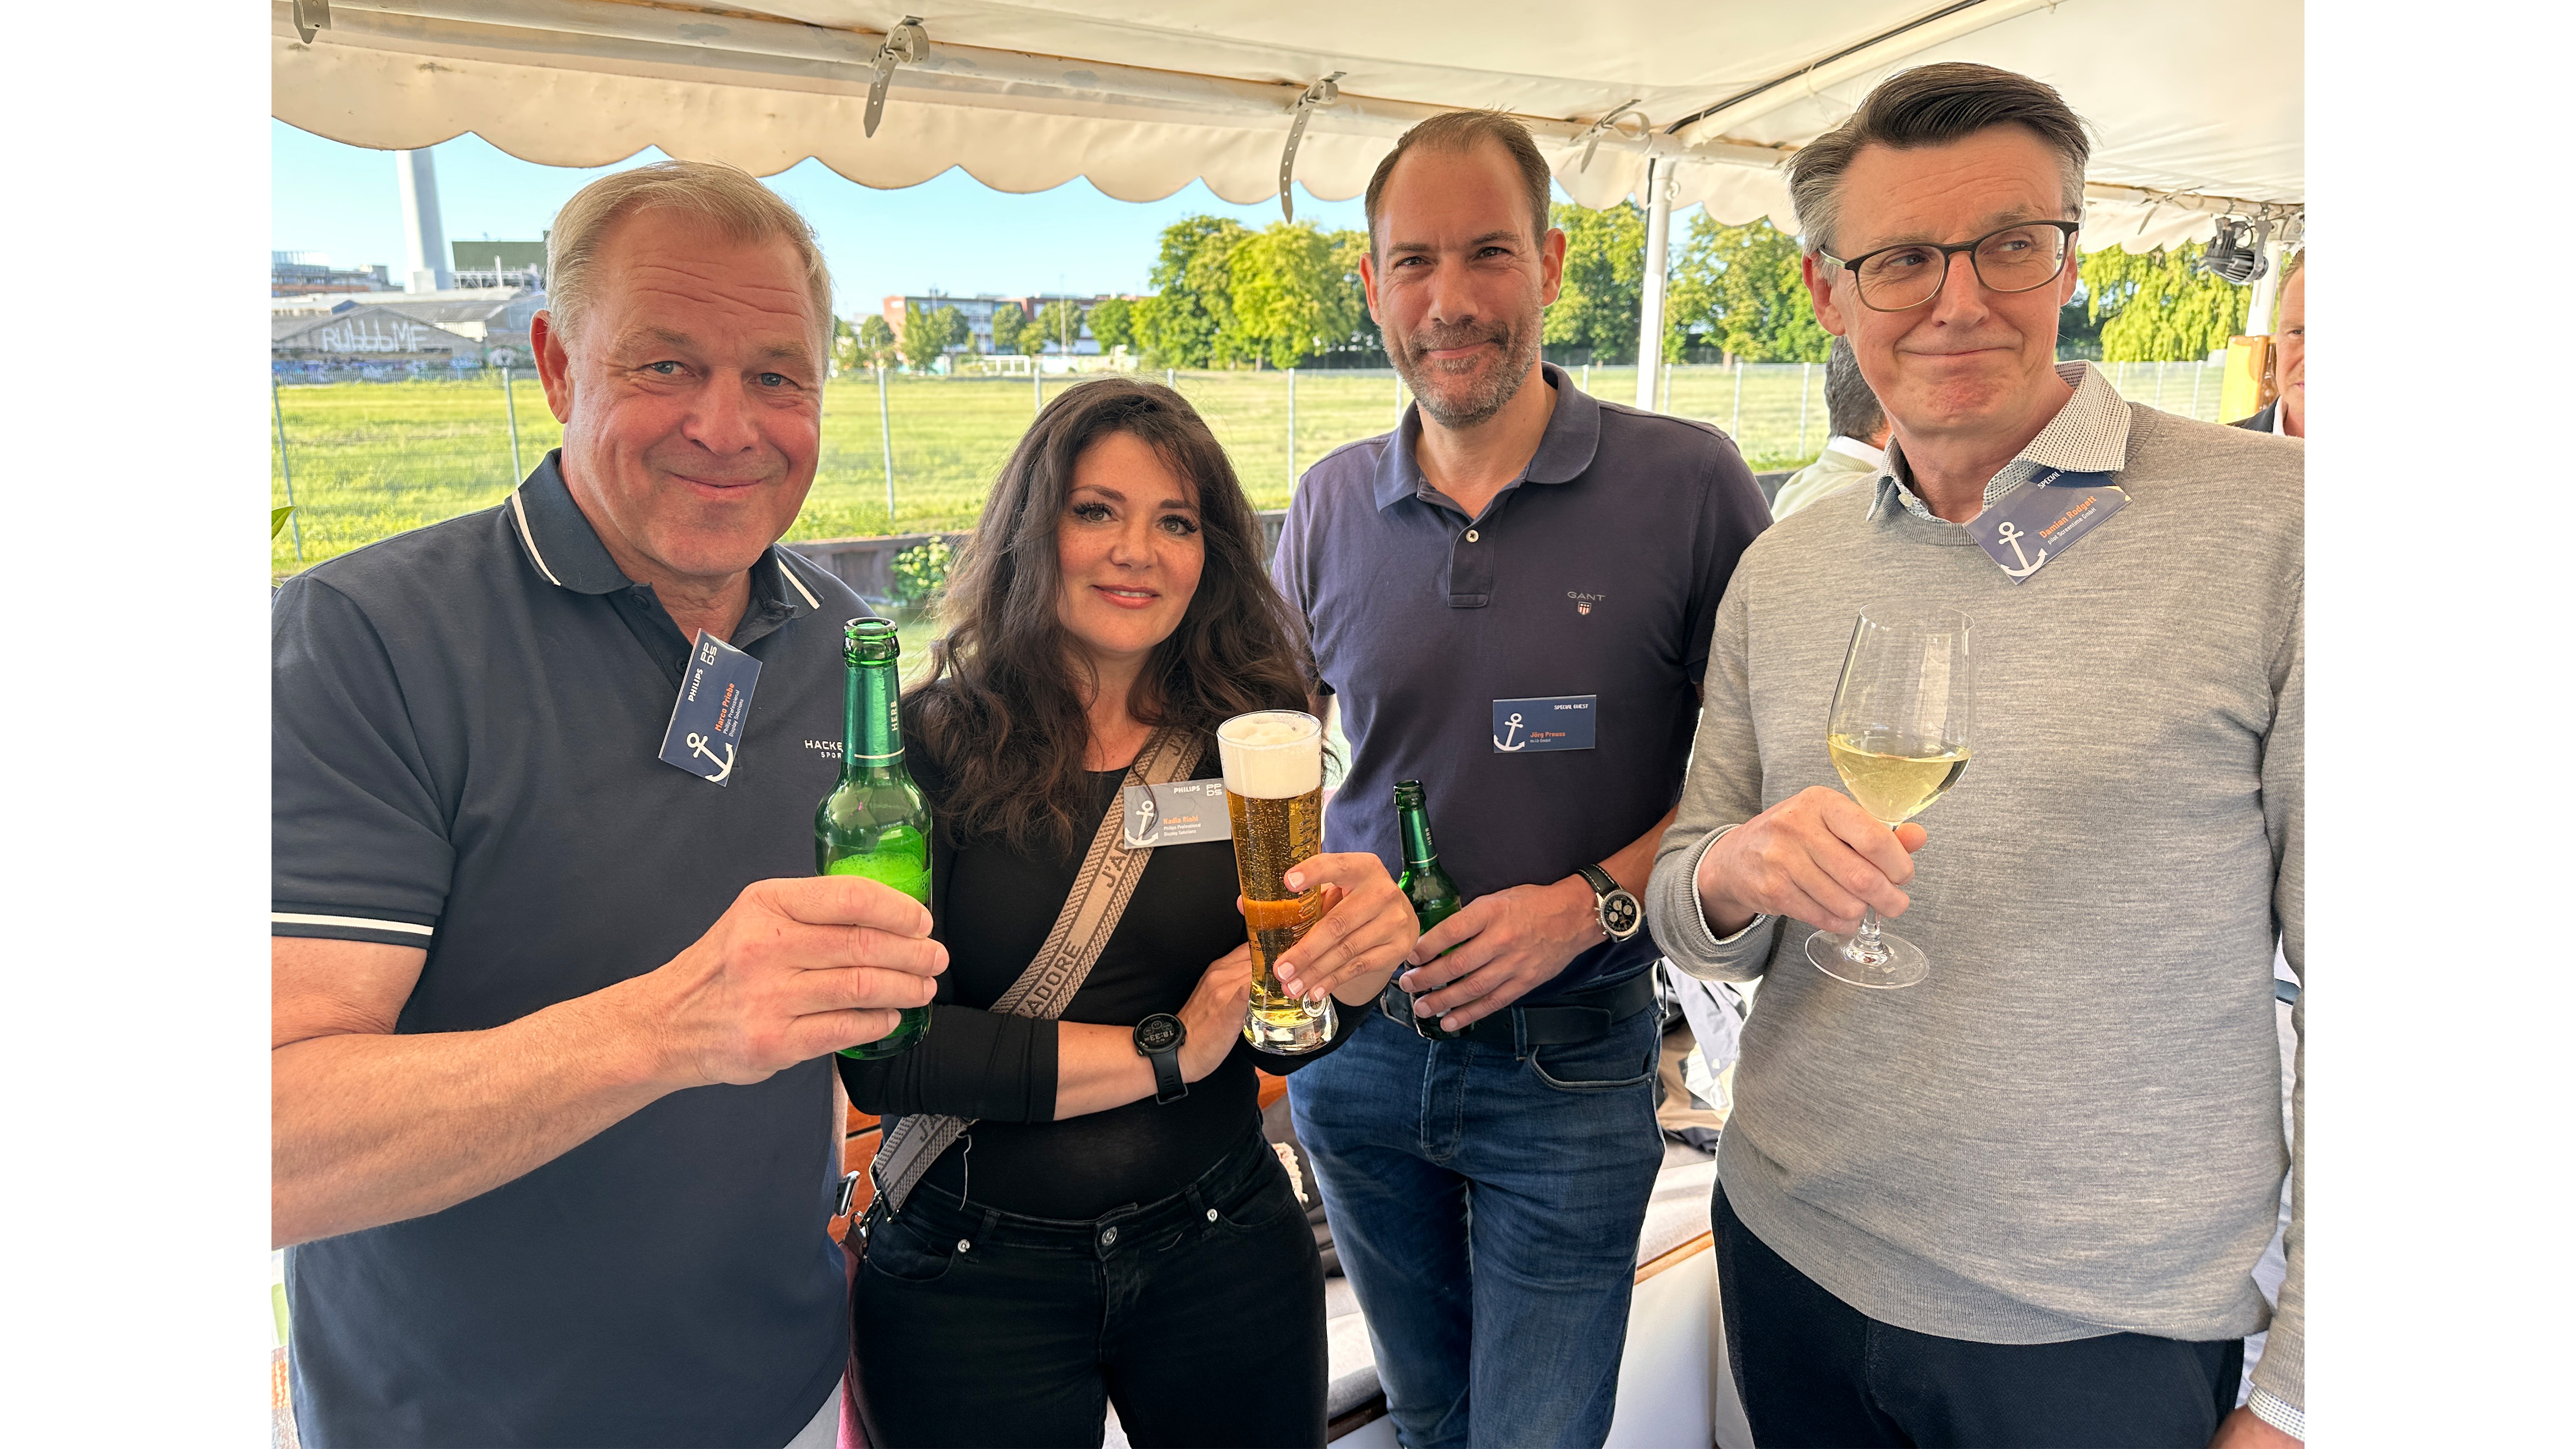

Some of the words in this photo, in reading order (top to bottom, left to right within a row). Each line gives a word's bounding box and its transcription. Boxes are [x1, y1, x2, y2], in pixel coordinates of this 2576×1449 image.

[2037, 471, 2061, 489] SPECIAL
[2039, 515, 2069, 539] Damian
[2065, 495, 2097, 519] Rodgett
[2047, 534, 2059, 545] pilot
[2056, 516, 2083, 537] Screentime
[2081, 506, 2097, 520] GmbH
[1567, 591, 1606, 601] GANT
[687, 668, 703, 702] PHILIPS
[715, 708, 727, 731] Marco
[722, 683, 735, 707] Priebe
[723, 718, 732, 734] Philips
[728, 690, 740, 718] Professional
[728, 720, 738, 737] Display
[734, 698, 744, 720] Solutions
[804, 739, 842, 751] HACKE
[1174, 785, 1200, 793] PHILIPS
[1101, 838, 1131, 888] J'AD
[1015, 940, 1082, 1015] 'ADORE
